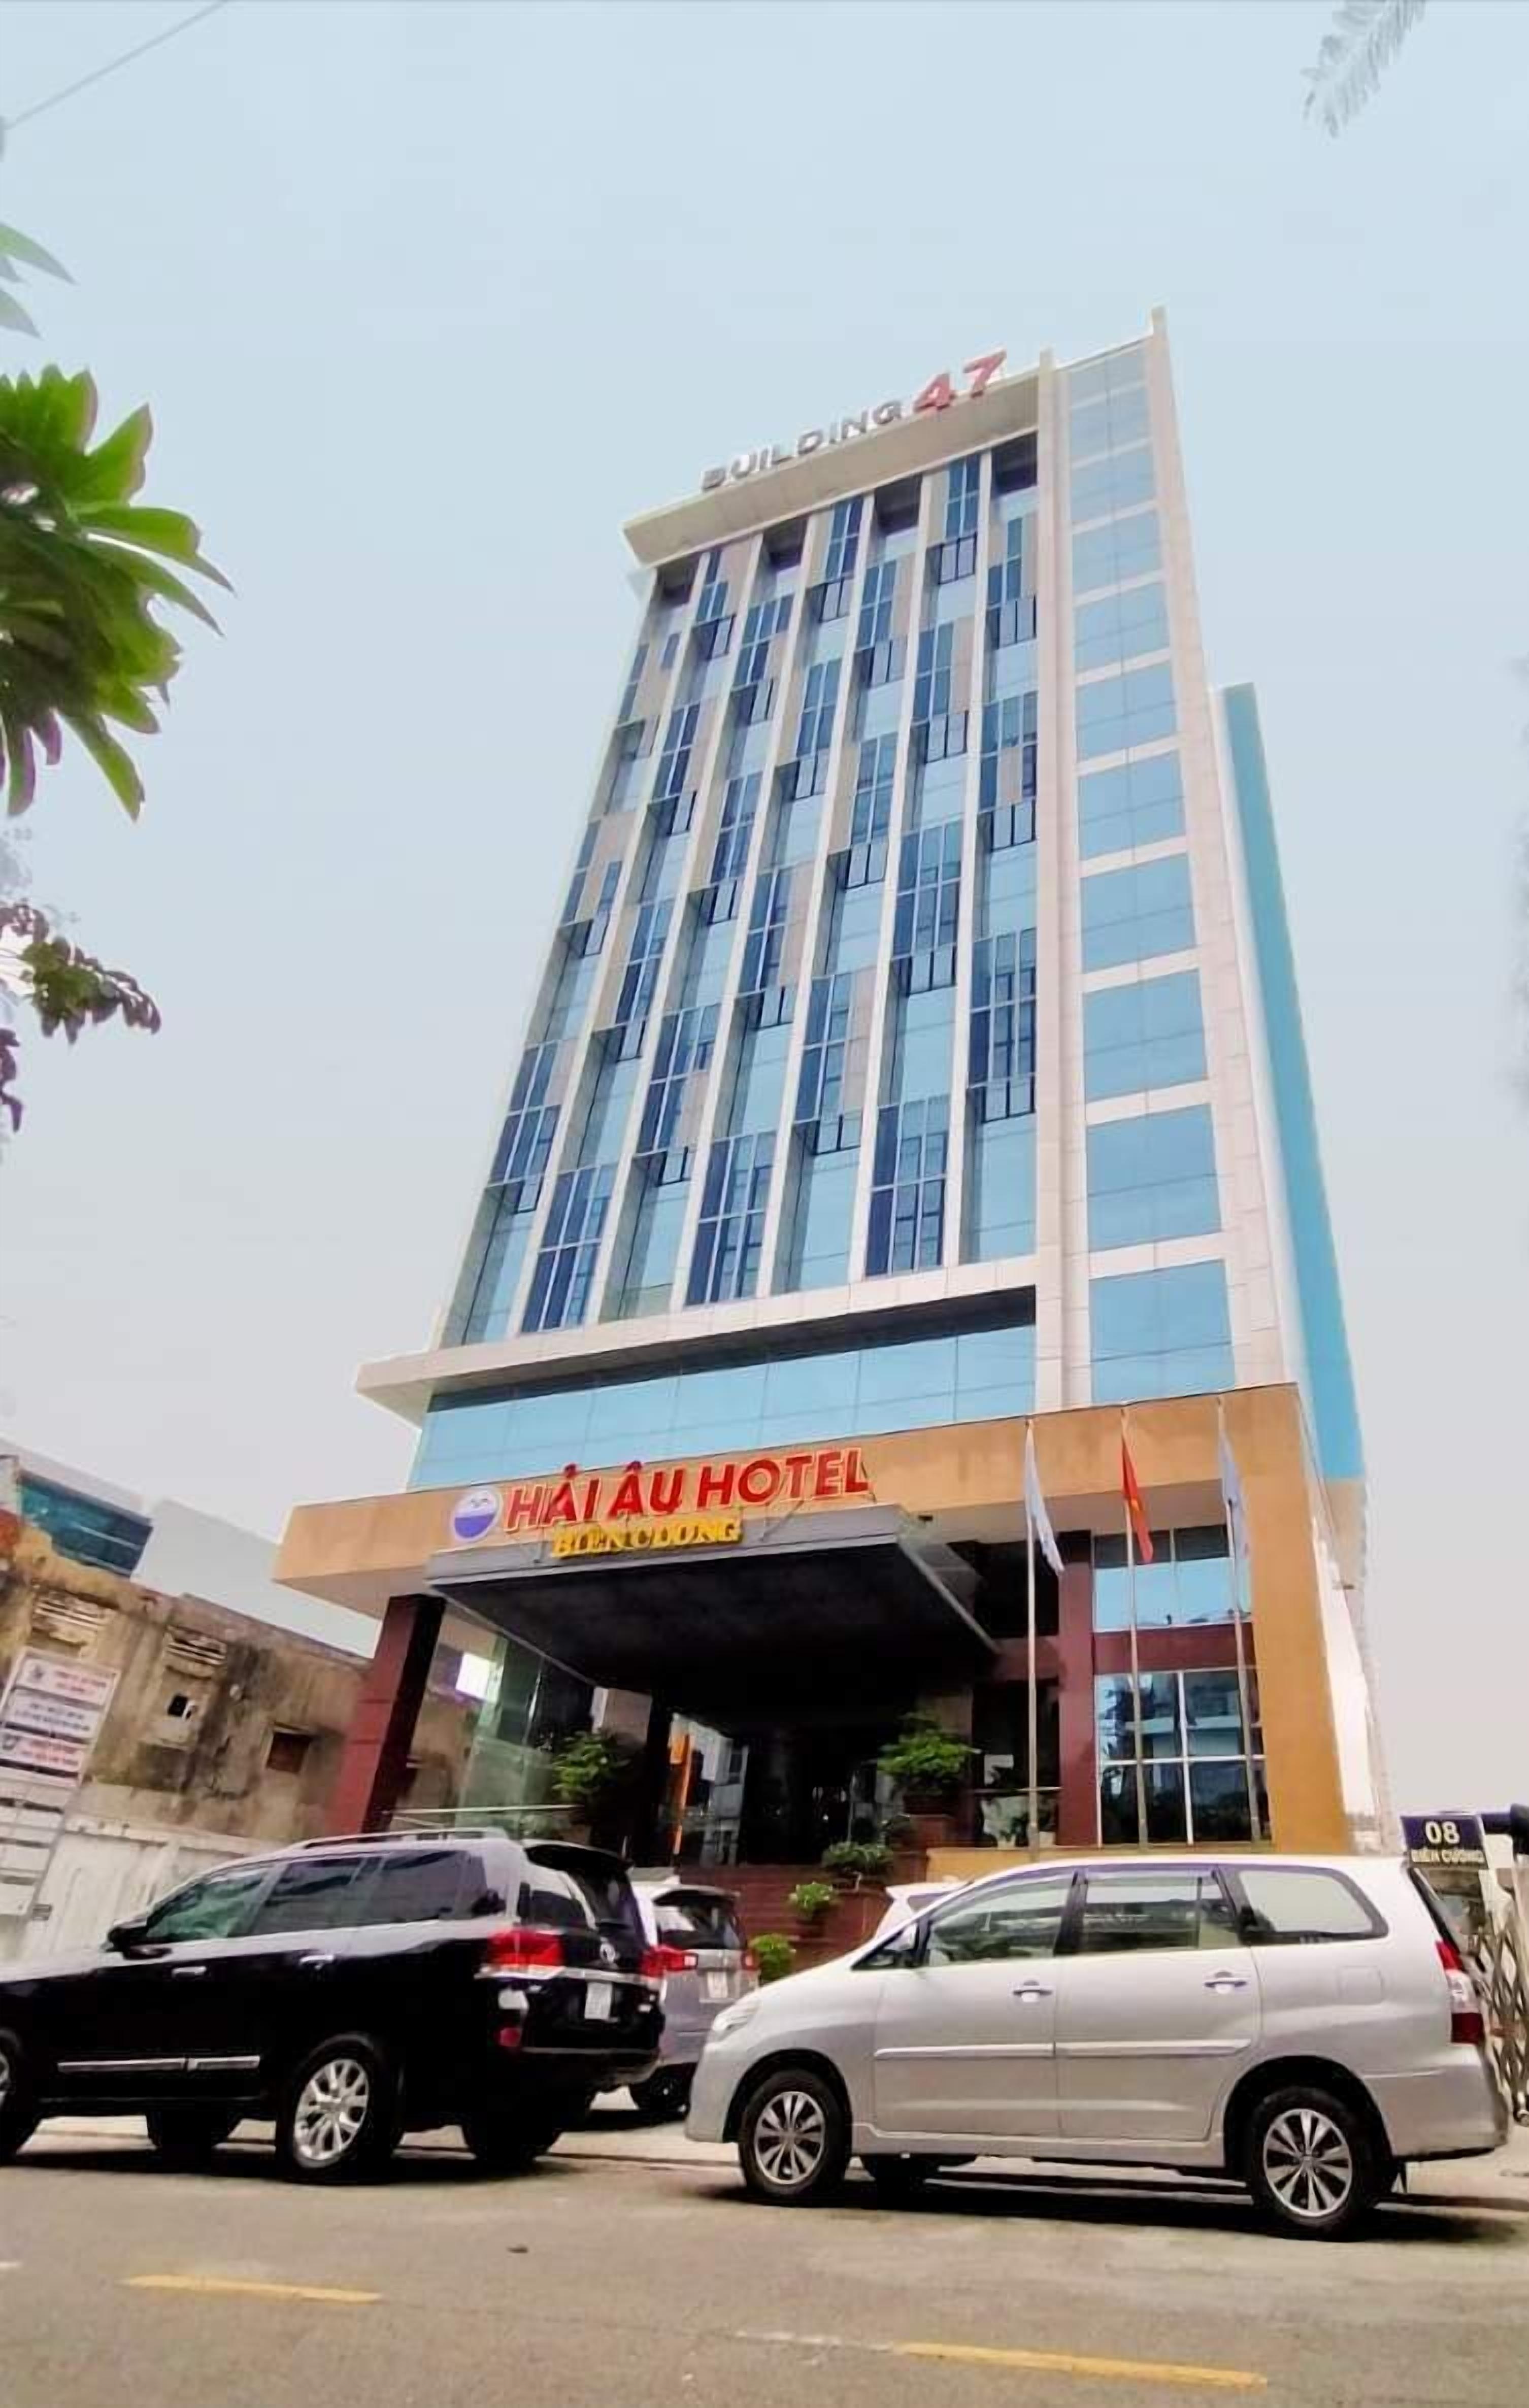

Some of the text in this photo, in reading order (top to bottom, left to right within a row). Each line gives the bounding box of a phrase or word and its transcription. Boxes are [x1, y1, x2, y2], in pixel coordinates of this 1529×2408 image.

[702, 348, 1008, 491] BUILDING 47
[507, 1449, 869, 1529] HẢI ÂU HOTEL
[1425, 1820, 1460, 1844] 08
